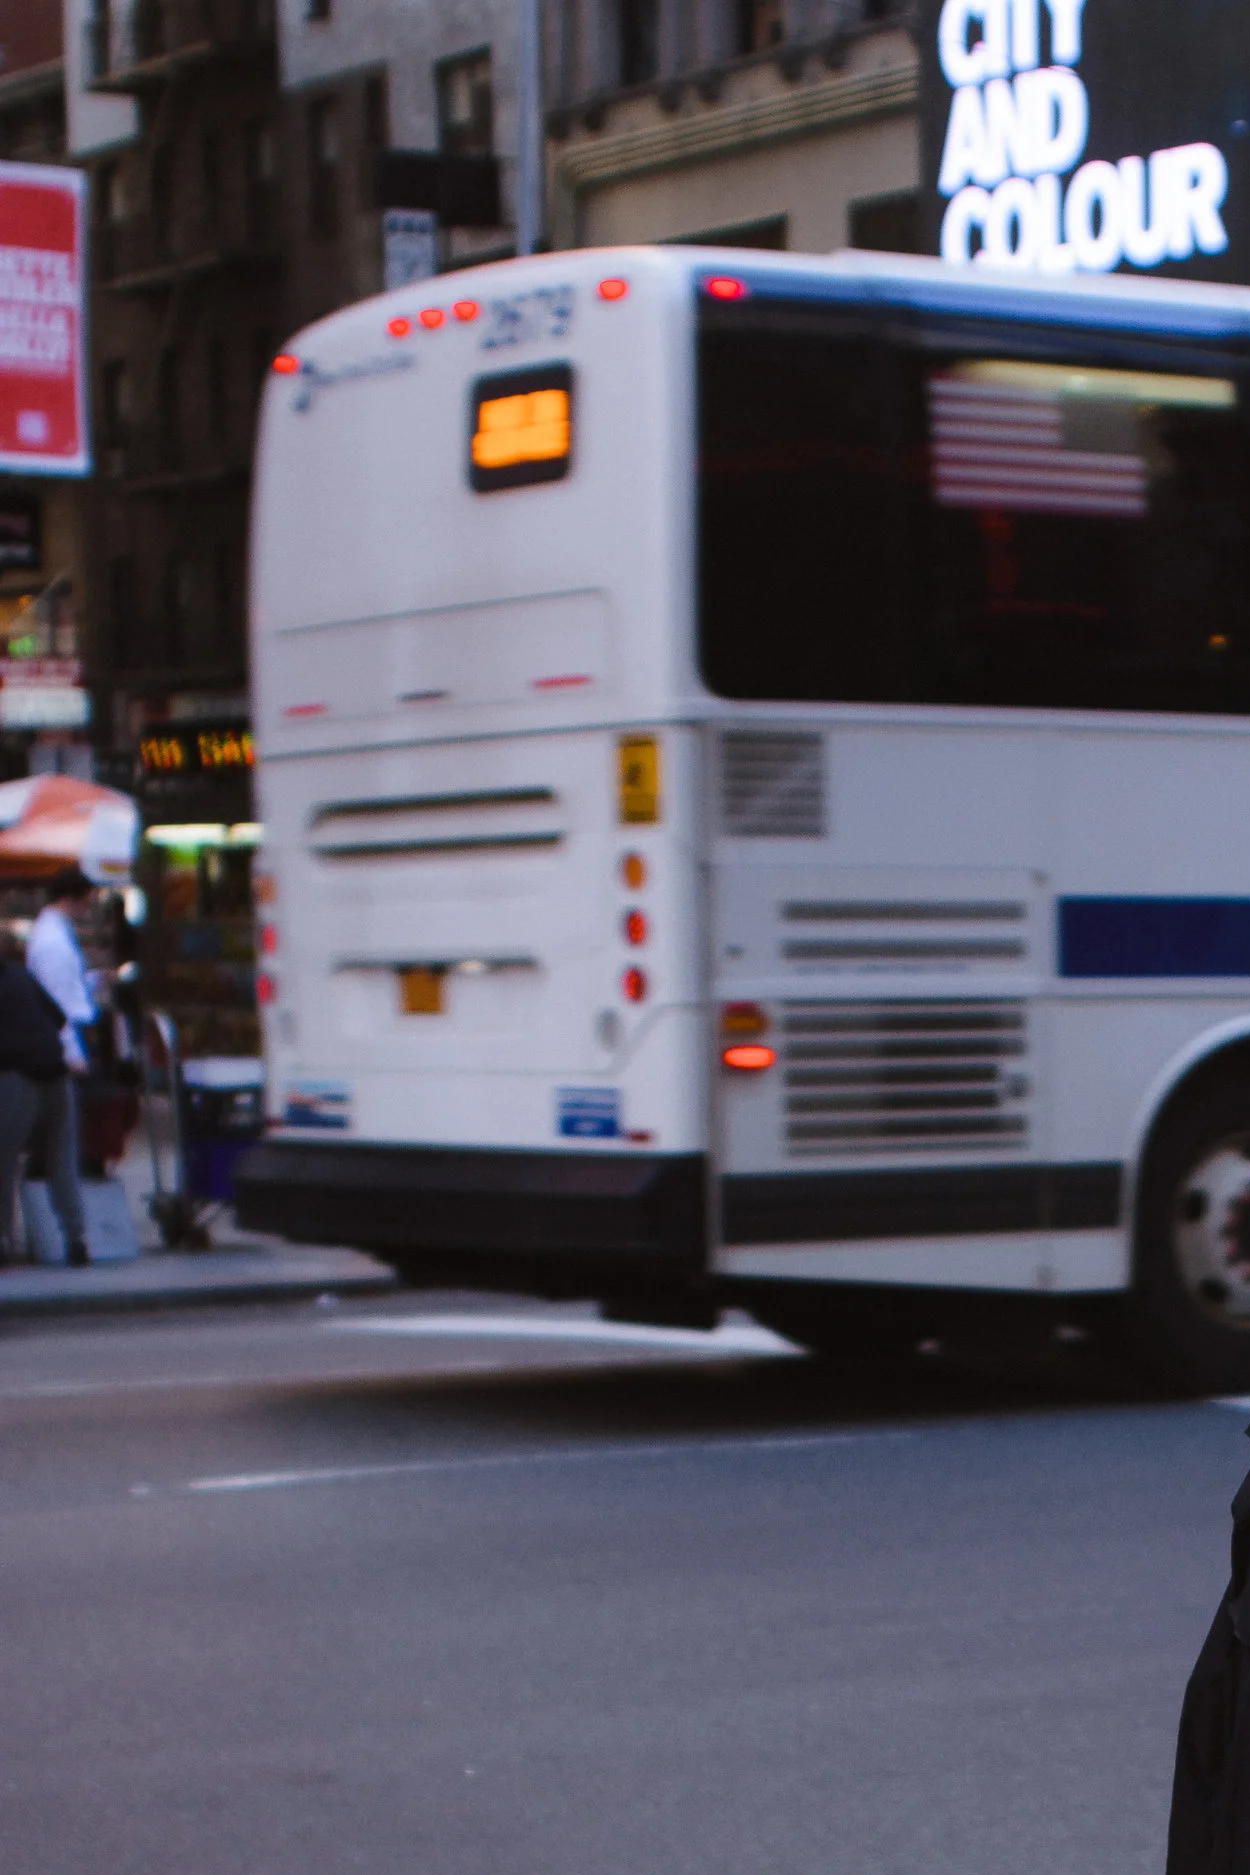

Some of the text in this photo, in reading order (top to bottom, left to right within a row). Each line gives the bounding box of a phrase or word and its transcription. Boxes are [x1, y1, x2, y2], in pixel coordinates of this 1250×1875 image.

[938, 0, 1087, 88] CITY
[937, 66, 1089, 198] AND
[939, 141, 1230, 273] COLOUR
